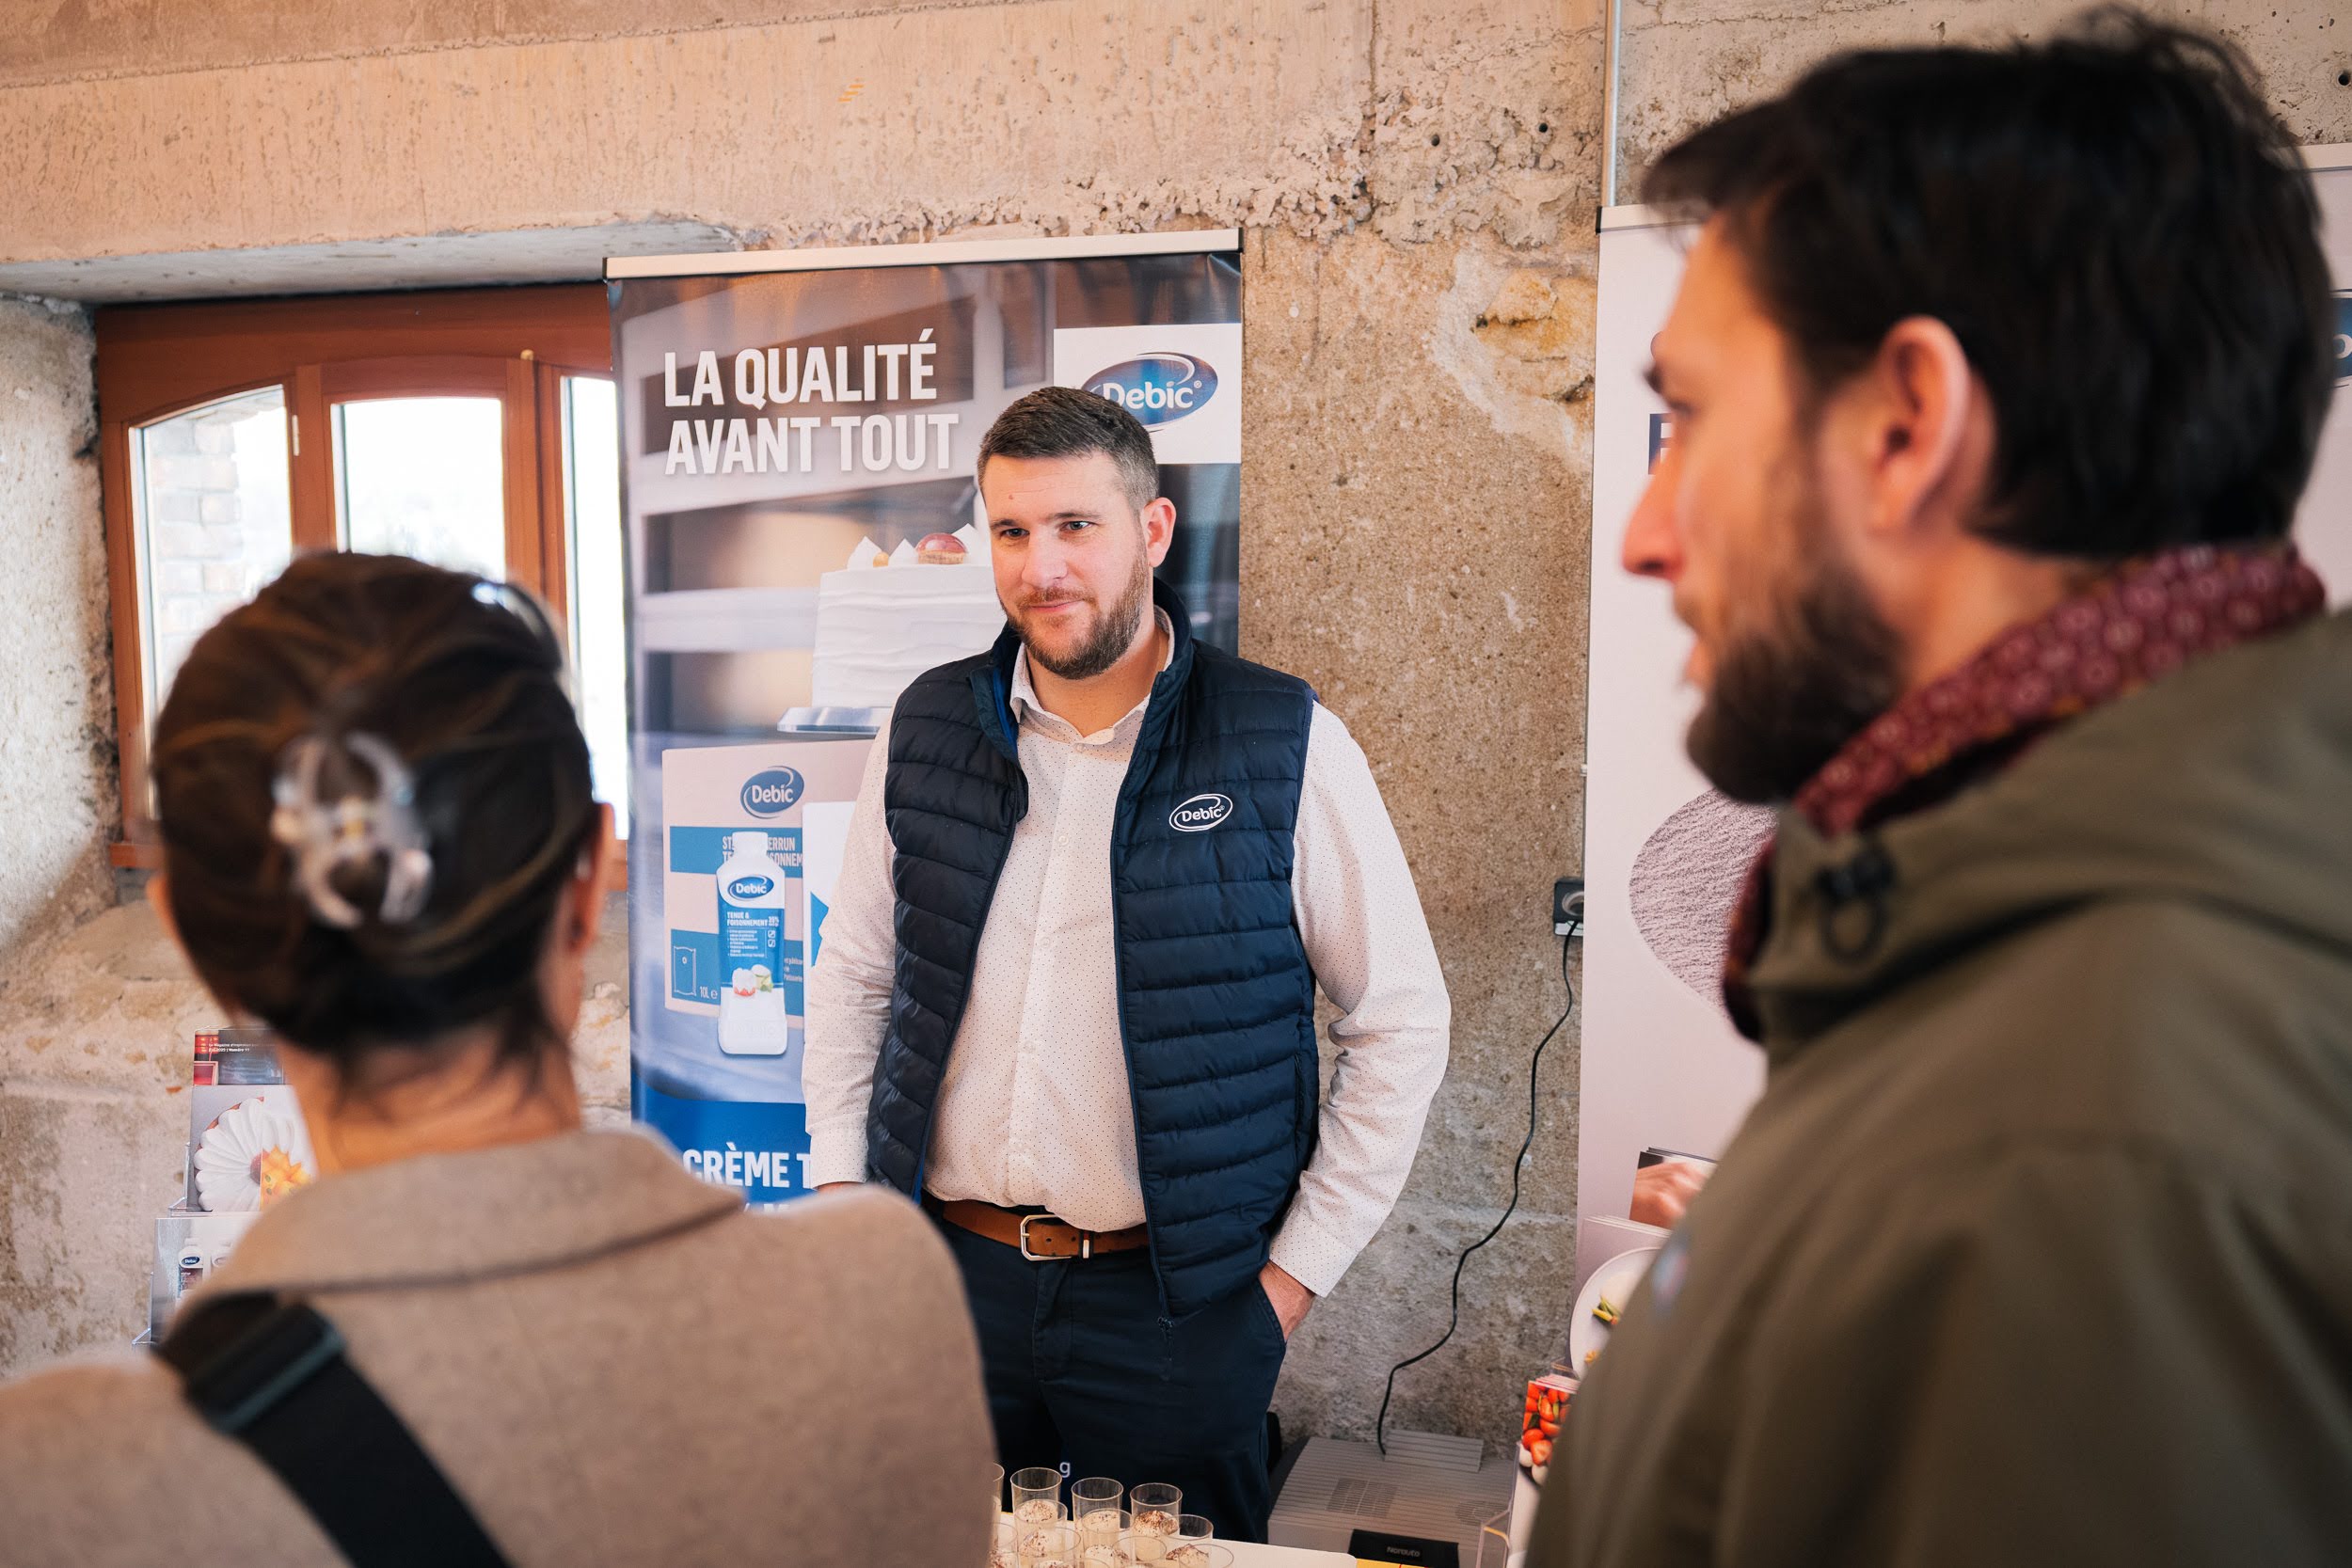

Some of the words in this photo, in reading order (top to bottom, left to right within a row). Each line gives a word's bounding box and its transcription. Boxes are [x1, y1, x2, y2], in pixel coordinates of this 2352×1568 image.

[664, 350, 724, 406] LA
[735, 327, 937, 410] QUALITÉ
[664, 415, 820, 475] AVANT
[831, 413, 959, 471] TOUT
[751, 784, 794, 803] Debic
[1181, 807, 1222, 822] Debic
[736, 881, 768, 895] Debic
[682, 1141, 790, 1187] CRÈME
